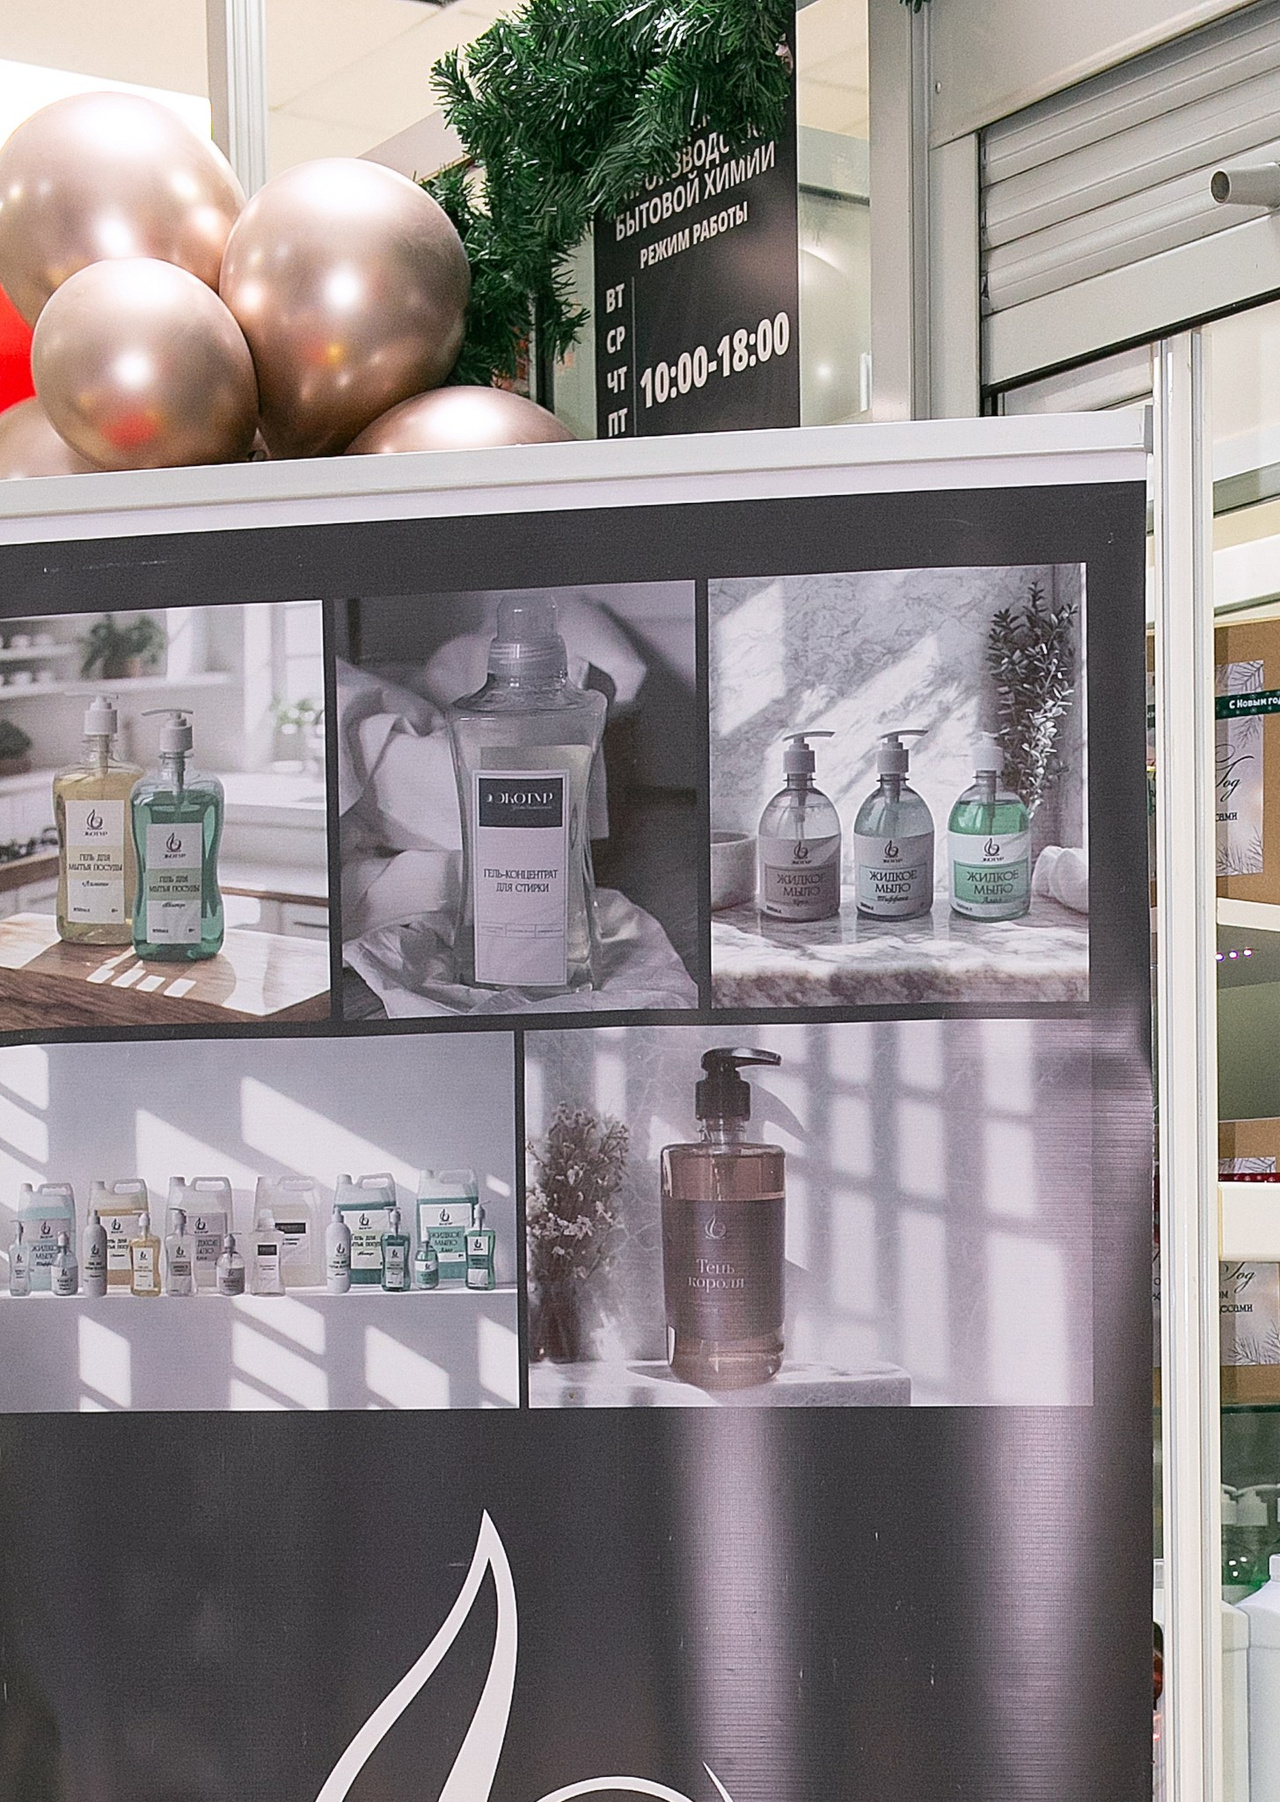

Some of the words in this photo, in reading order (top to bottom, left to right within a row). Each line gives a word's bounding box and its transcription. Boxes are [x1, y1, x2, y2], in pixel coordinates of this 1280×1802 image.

[616, 171, 699, 241] БЫТОВОЙ
[704, 140, 775, 199] ХИМИИ
[640, 227, 690, 269] РЕЖИМ
[693, 201, 748, 245] РАБОТЫ
[606, 283, 625, 313] ВТ
[606, 326, 626, 354] СР
[640, 311, 790, 409] 10:00-18:00
[607, 366, 627, 394] ЧТ
[608, 408, 628, 437] ПТ
[483, 868, 558, 880] ГЕЛЬ-КОНЦЕНТРАТ
[869, 869, 918, 882] ЖИДКОЕ
[967, 869, 1020, 882] ЖИДКОЕ
[496, 883, 513, 893] ДЛЯ
[515, 883, 550, 893] СТИРКИ
[783, 887, 820, 897] МЫЛО
[875, 883, 911, 893] МЫЛО
[974, 883, 1013, 895] МЫЛО
[696, 1258, 735, 1275] Тень
